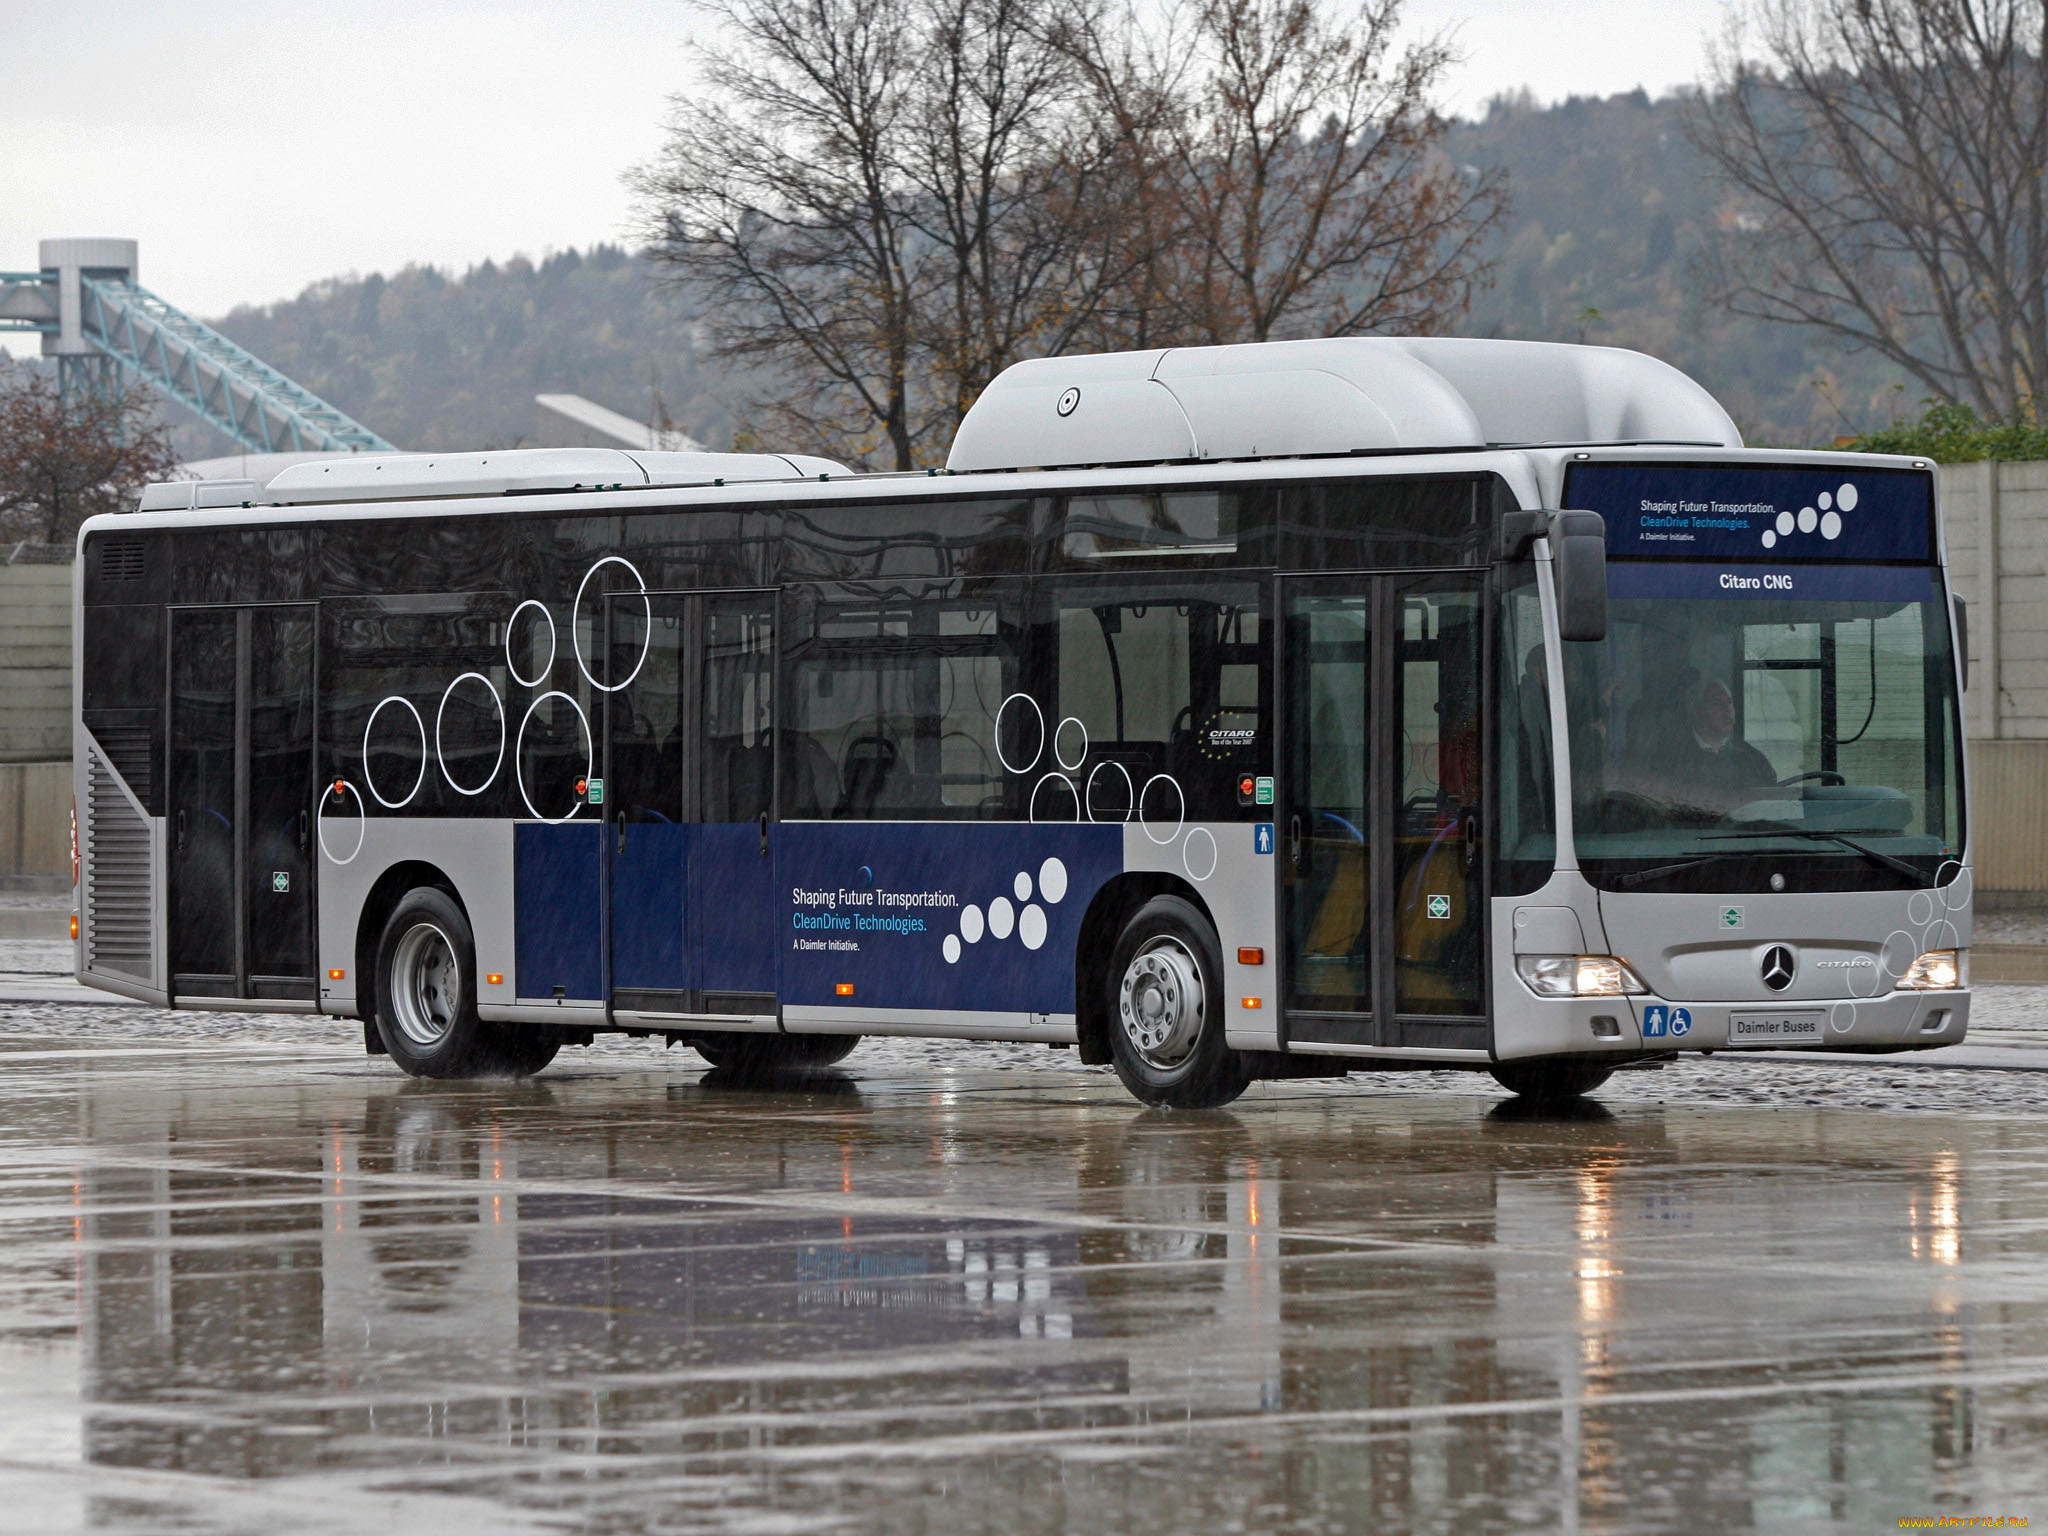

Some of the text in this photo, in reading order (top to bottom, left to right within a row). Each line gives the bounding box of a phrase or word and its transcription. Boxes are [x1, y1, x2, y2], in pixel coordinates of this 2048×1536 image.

[1640, 500, 1776, 516] Shaping Future Transportation.
[1640, 515, 1750, 530] CleanDrive Technologies.
[1645, 533, 1668, 541] Daimler
[1669, 533, 1696, 542] Initiative.
[1719, 573, 1793, 590] Citaro CNG
[792, 887, 959, 910] Shaping Future Transportation.
[792, 912, 927, 936] CleanDrive Technologies.
[792, 939, 860, 952] A Daimler Initiative.
[1816, 960, 1873, 969] CITARO
[1737, 1020, 1816, 1034] Daimler Buses
